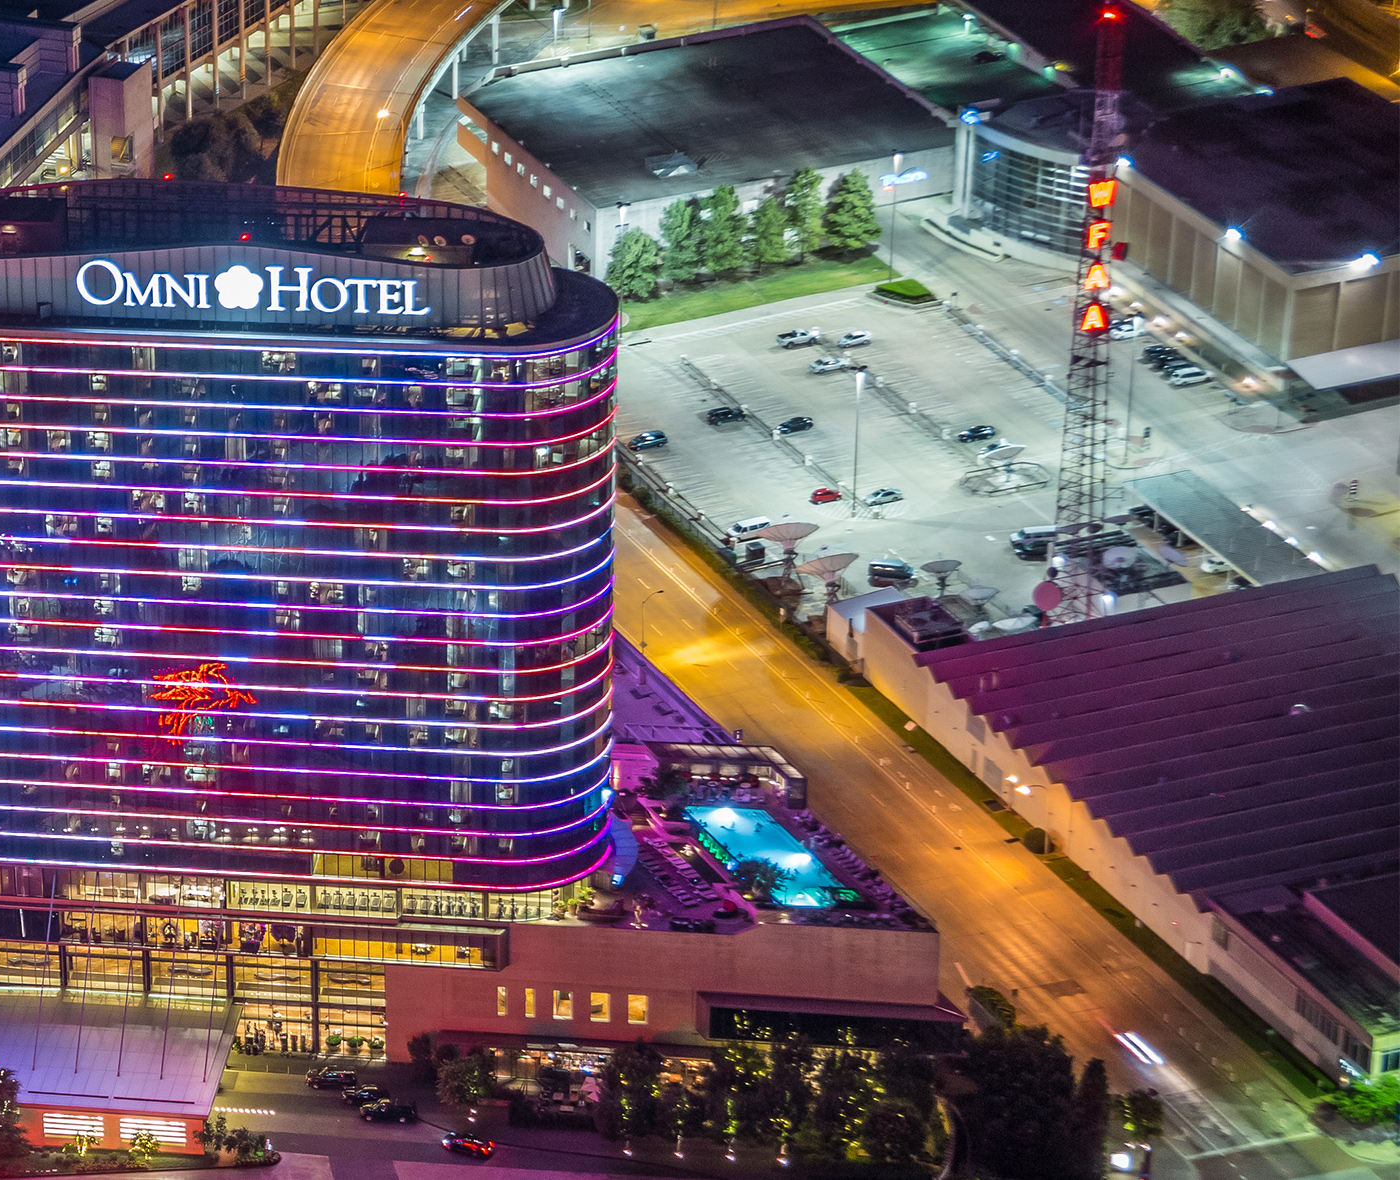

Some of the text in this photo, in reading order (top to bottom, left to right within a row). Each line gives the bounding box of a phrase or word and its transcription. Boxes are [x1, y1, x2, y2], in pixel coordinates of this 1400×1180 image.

[76, 259, 432, 316] OMNI HOTEL
[1081, 179, 1118, 331] WFAA
